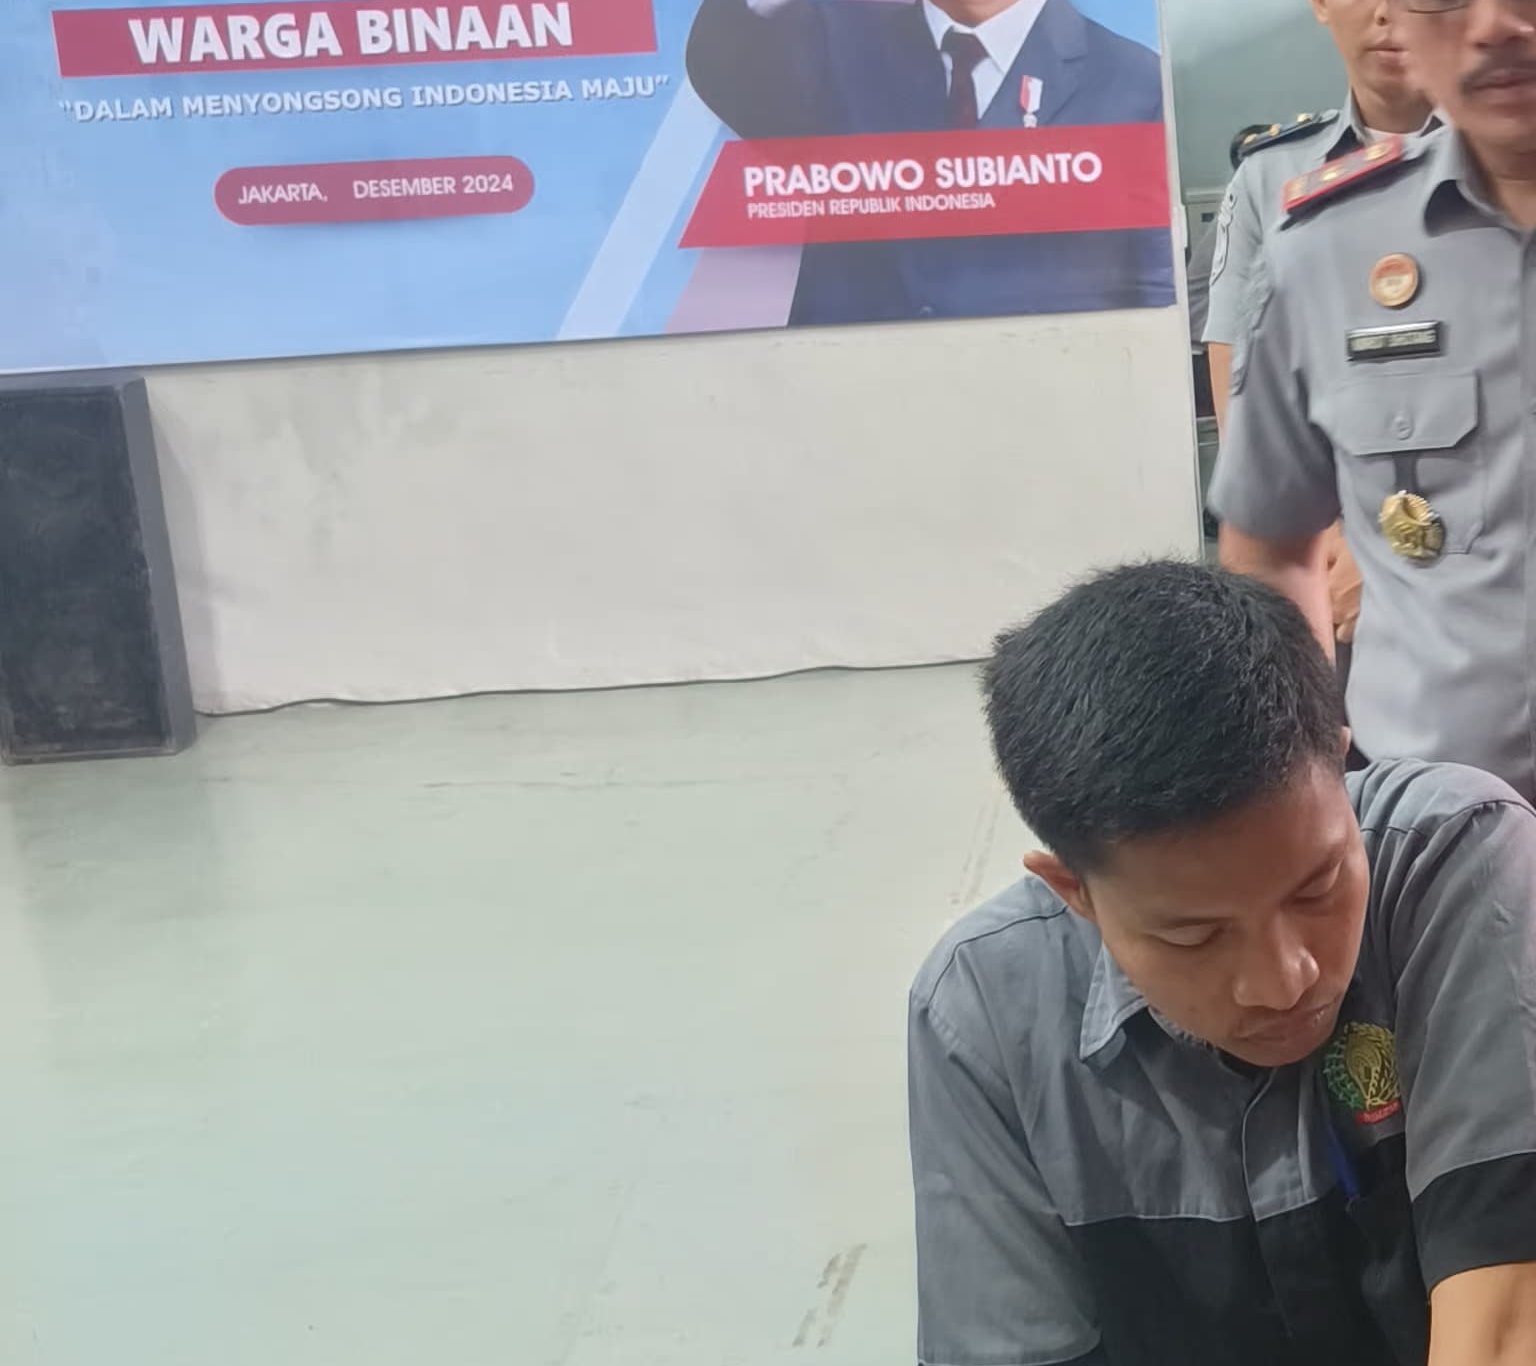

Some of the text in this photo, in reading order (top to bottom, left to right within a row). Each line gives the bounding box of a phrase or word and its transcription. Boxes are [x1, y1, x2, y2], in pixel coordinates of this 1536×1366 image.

[127, 1, 574, 65] WARGA BINAAN
[182, 86, 403, 118] MENYONGSONG
[411, 80, 571, 108] INDONESIA
[237, 171, 514, 206] JAKARTA, DESEMBER 2024
[743, 150, 1103, 198] PRABOWO SUBIANTO
[747, 192, 996, 220] PRESIDEN REPUBLIK INDONESIA
